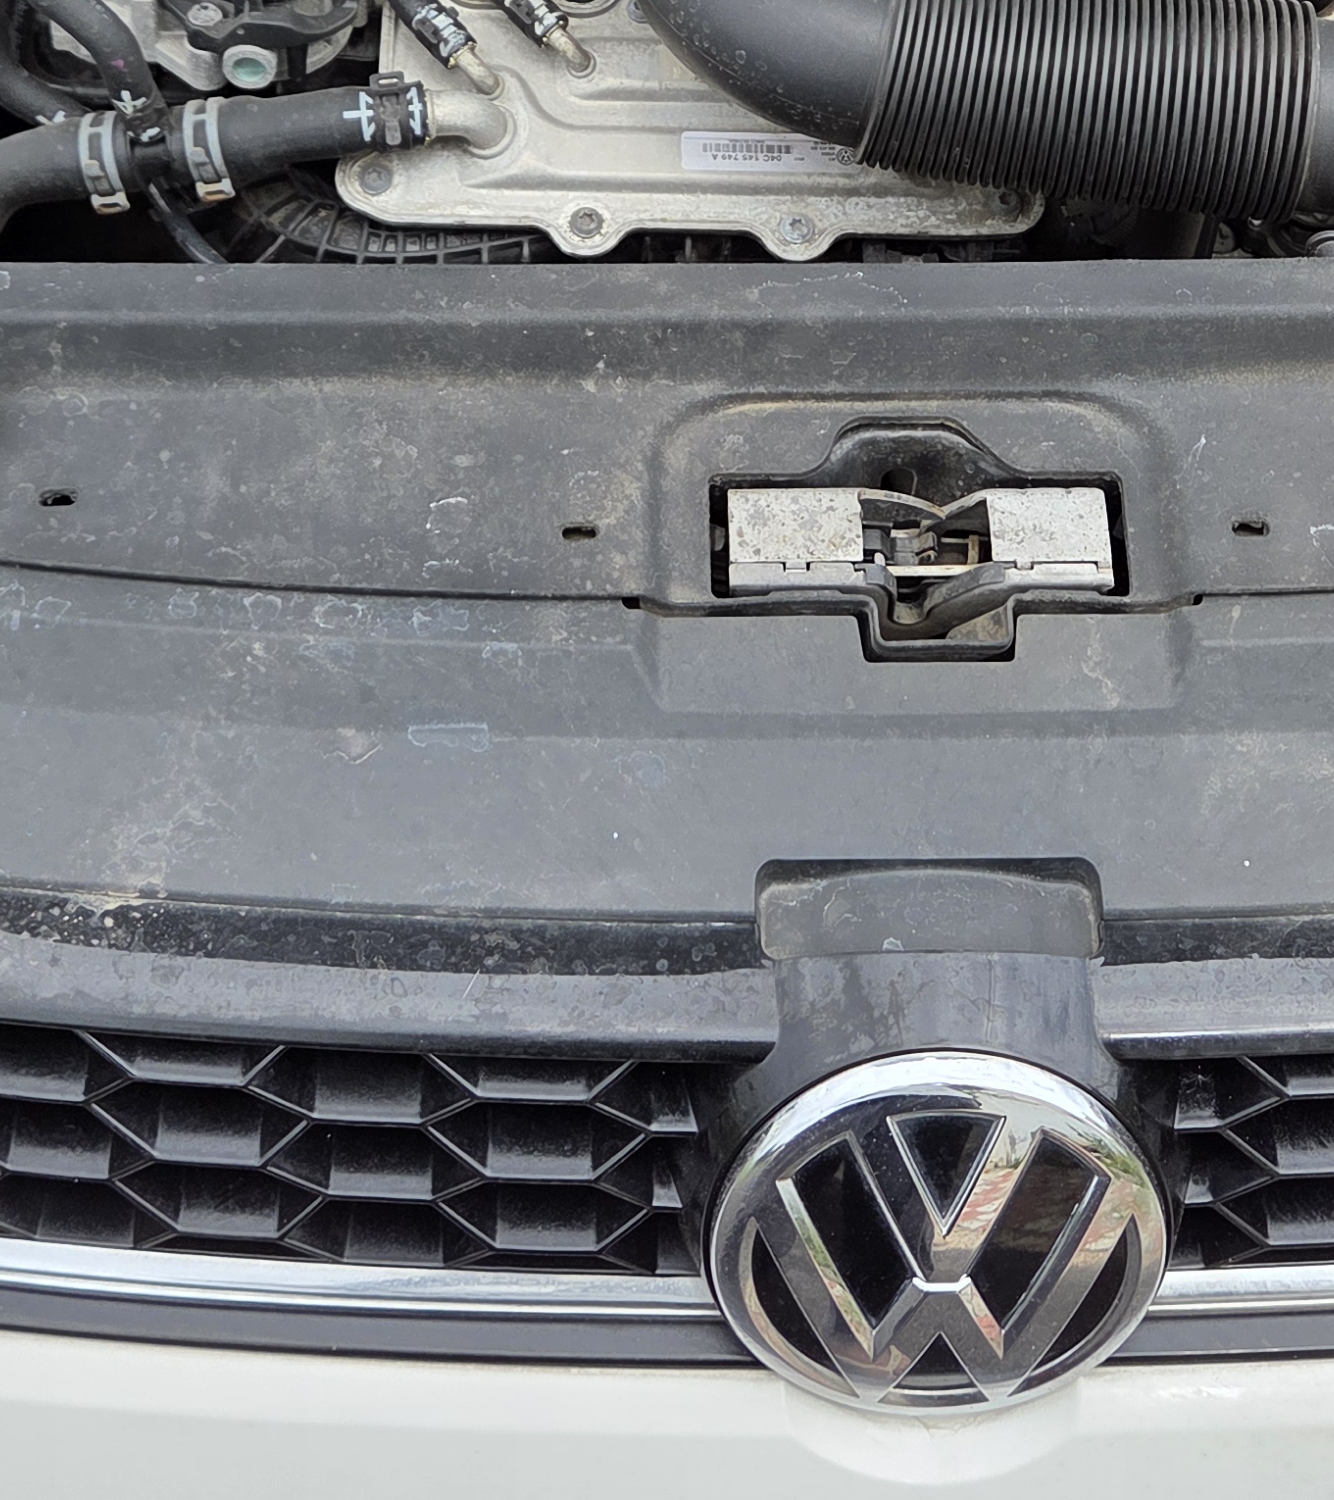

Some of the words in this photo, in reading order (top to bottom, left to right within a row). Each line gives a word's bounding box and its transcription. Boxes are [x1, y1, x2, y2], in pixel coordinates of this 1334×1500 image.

[712, 153, 718, 161] A
[721, 153, 739, 161] 749
[742, 153, 760, 162] 145
[722, 1070, 1159, 1408] VW
